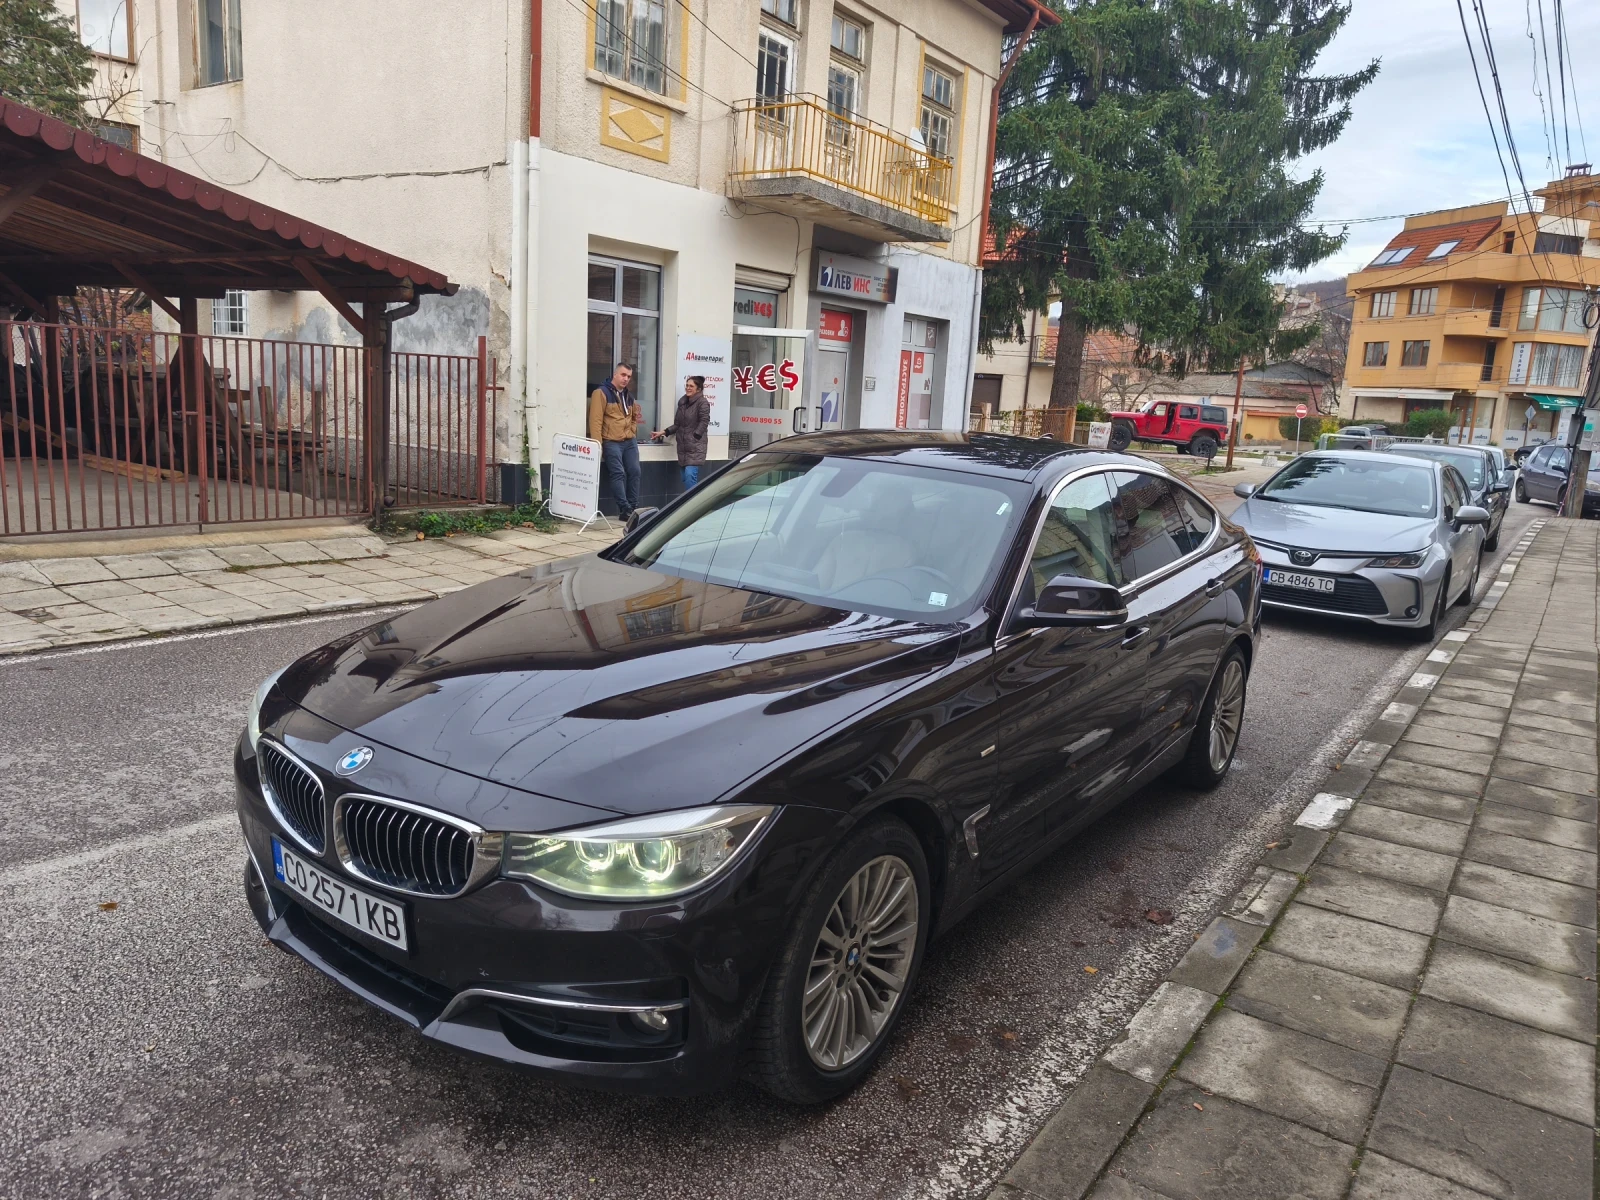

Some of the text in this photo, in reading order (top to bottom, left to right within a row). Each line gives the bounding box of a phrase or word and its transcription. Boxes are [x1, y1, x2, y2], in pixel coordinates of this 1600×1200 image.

[834, 274, 871, 294] ЛЕВ ИНС
[1270, 572, 1285, 583] CB
[1287, 575, 1315, 588] 4846
[1318, 579, 1333, 591] TC
[284, 852, 400, 941] CO 2571 KB
